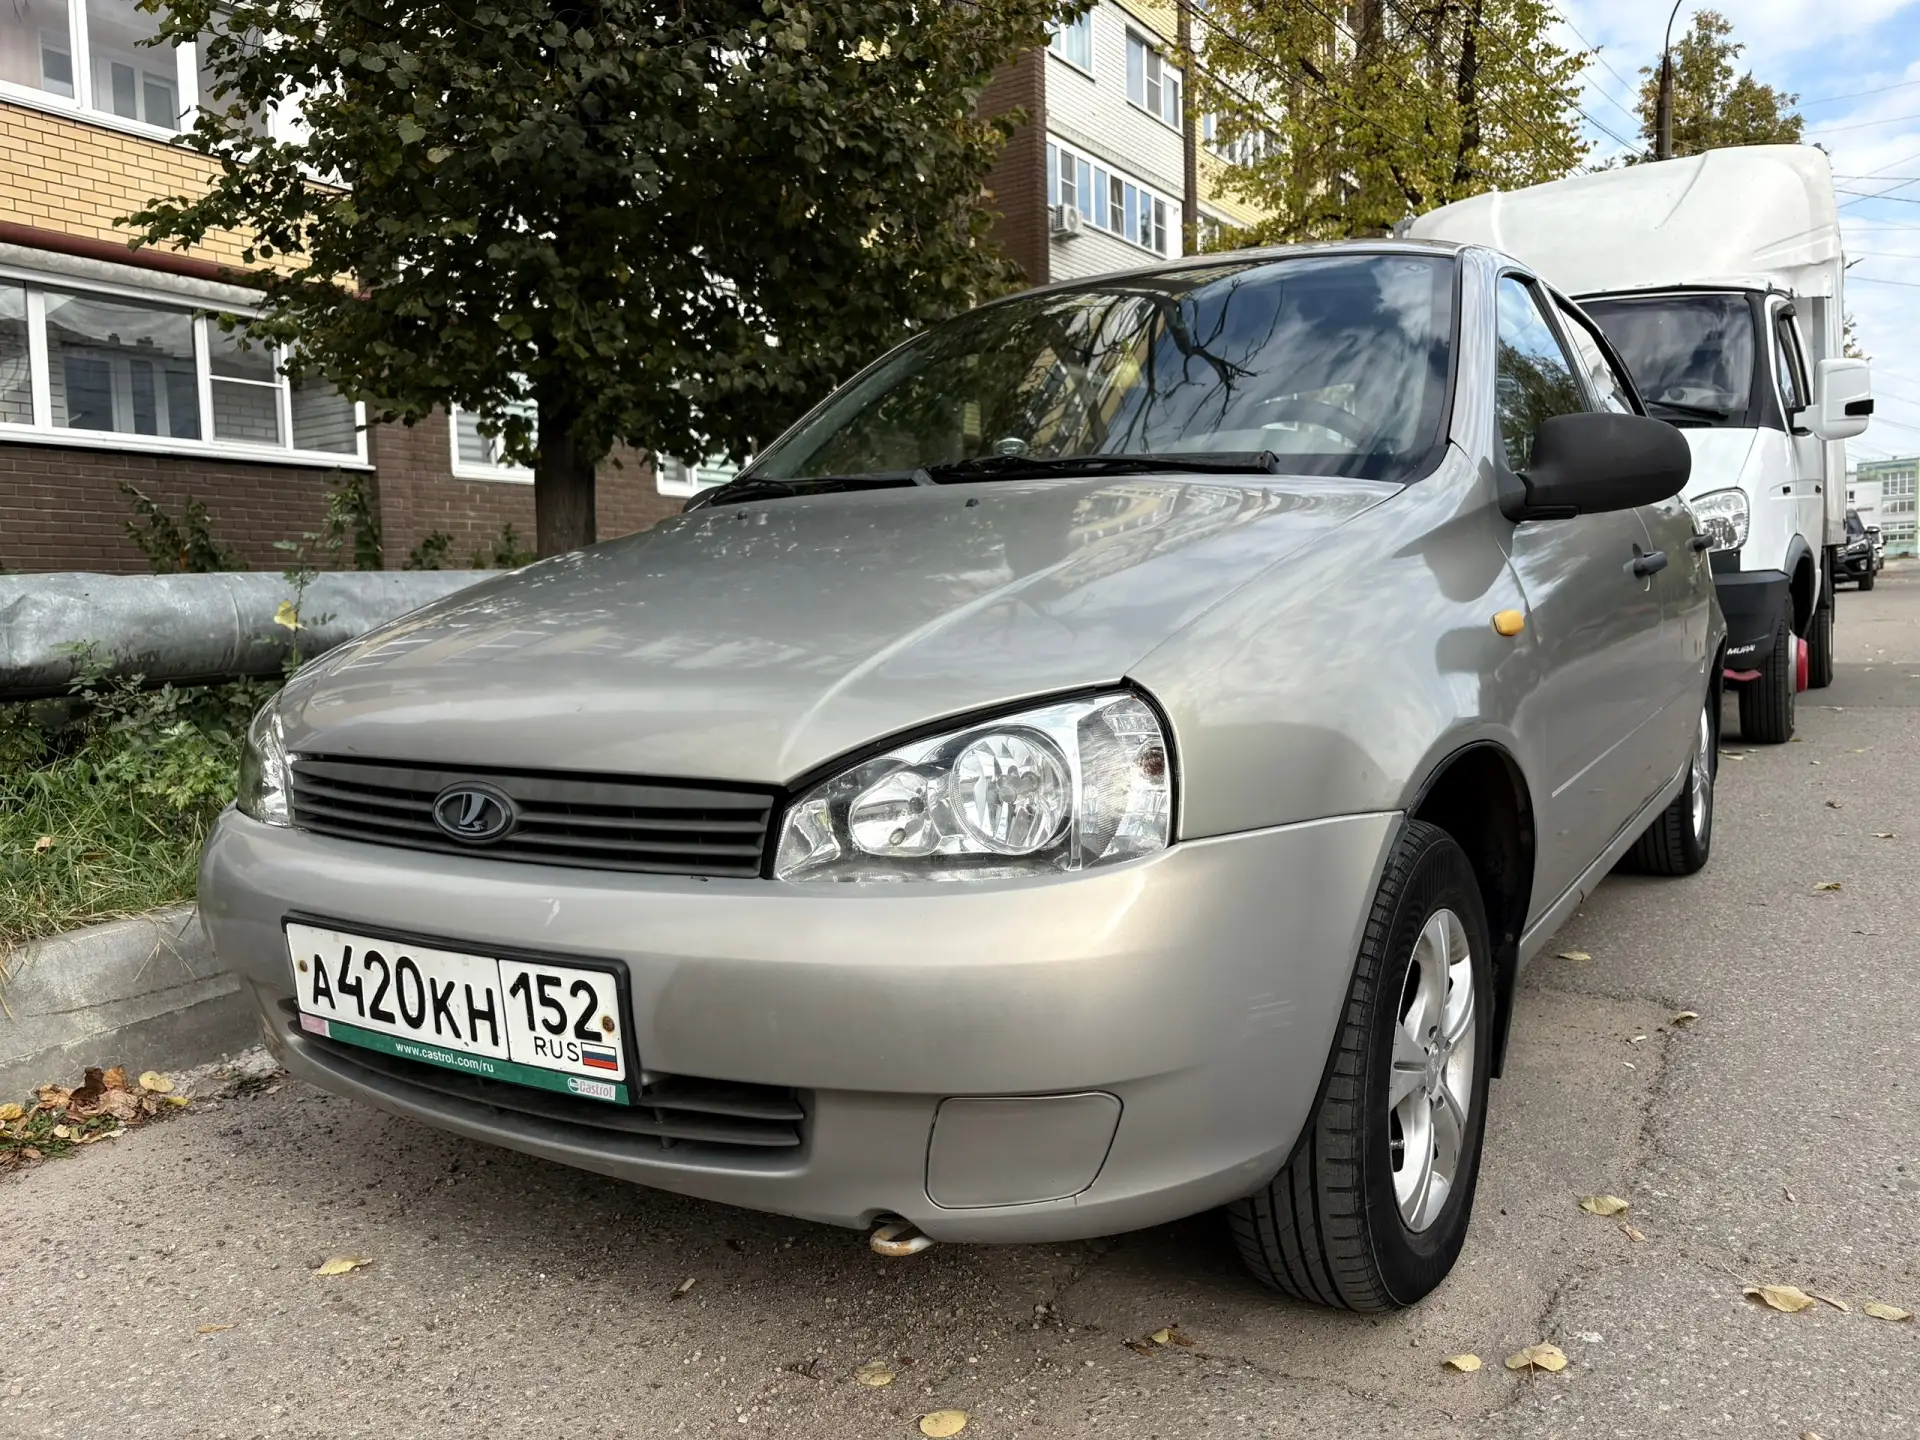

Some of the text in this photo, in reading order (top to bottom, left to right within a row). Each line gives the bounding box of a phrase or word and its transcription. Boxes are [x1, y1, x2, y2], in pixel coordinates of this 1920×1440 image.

[509, 972, 603, 1042] 152
[395, 1042, 494, 1073] www.castrol.com/ru
[534, 1036, 580, 1062] RUS
[580, 1080, 613, 1098] Castrol
